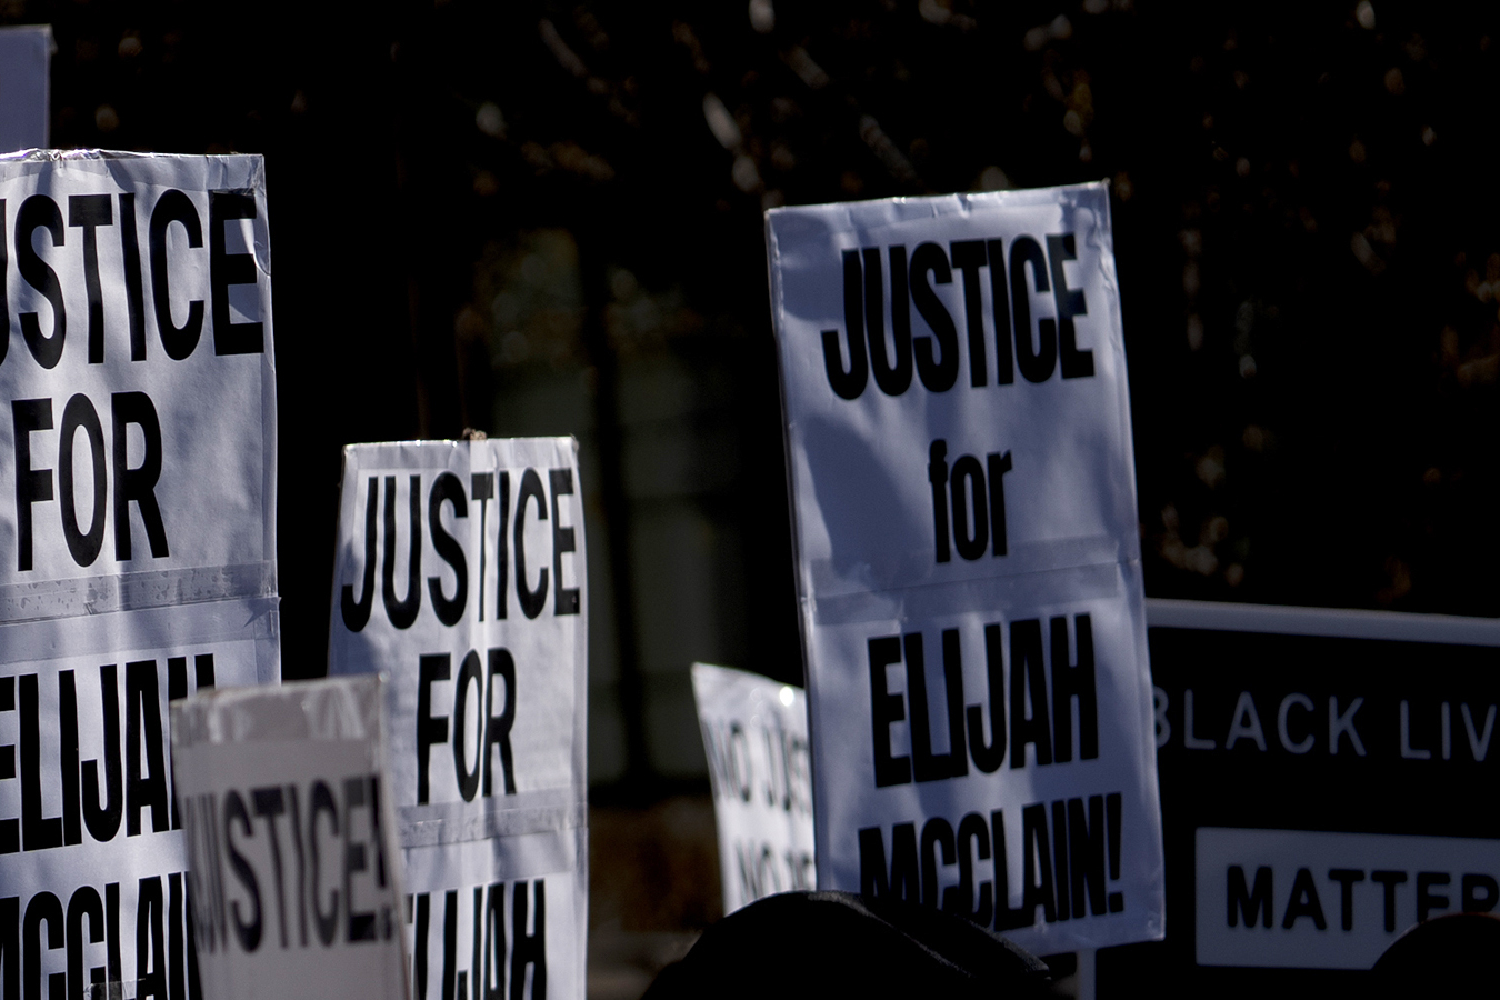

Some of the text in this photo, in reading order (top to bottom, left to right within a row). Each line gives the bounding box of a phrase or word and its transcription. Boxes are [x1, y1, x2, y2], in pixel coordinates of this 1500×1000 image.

[821, 234, 1095, 400] JUSTICE
[11, 391, 170, 571] FOR
[341, 468, 581, 632] JUSTICE
[929, 439, 1012, 563] for
[417, 648, 517, 805] FOR
[869, 613, 1100, 788] ELIJAH
[1152, 686, 1498, 762] BLACK LIV
[859, 793, 1124, 932] MCCLAIN!
[1227, 866, 1499, 932] MATTER
